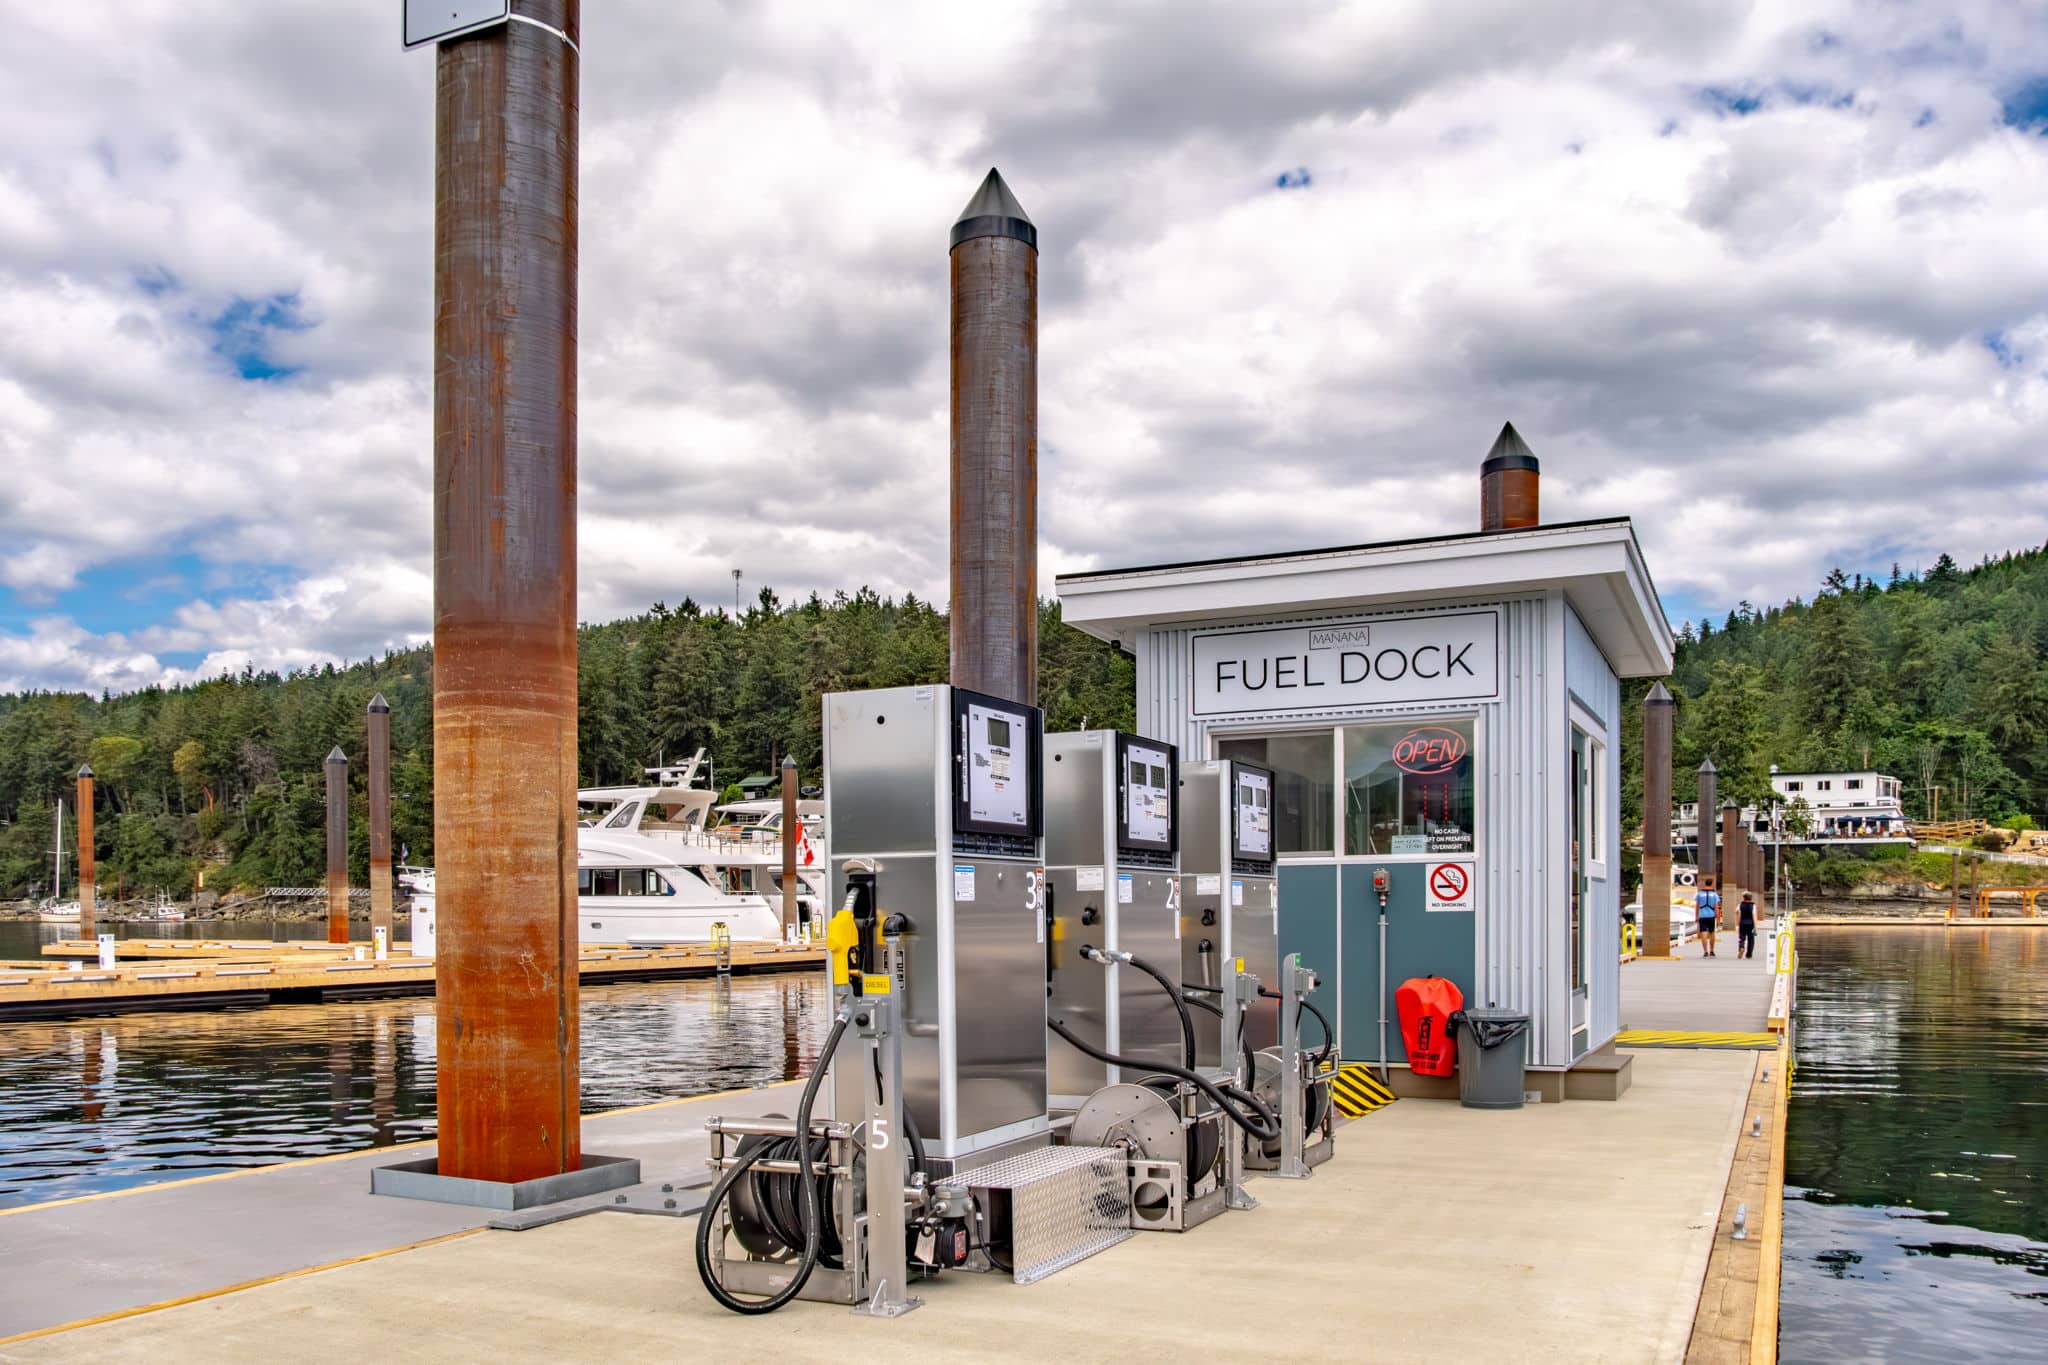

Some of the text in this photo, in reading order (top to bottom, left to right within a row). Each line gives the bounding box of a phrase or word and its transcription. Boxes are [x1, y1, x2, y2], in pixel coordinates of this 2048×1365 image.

[1217, 643, 1475, 692] FUEL DOCK
[1396, 738, 1459, 762] OPEN
[1025, 871, 1037, 910] 3
[1166, 877, 1174, 909] 2
[871, 1119, 889, 1150] 5
